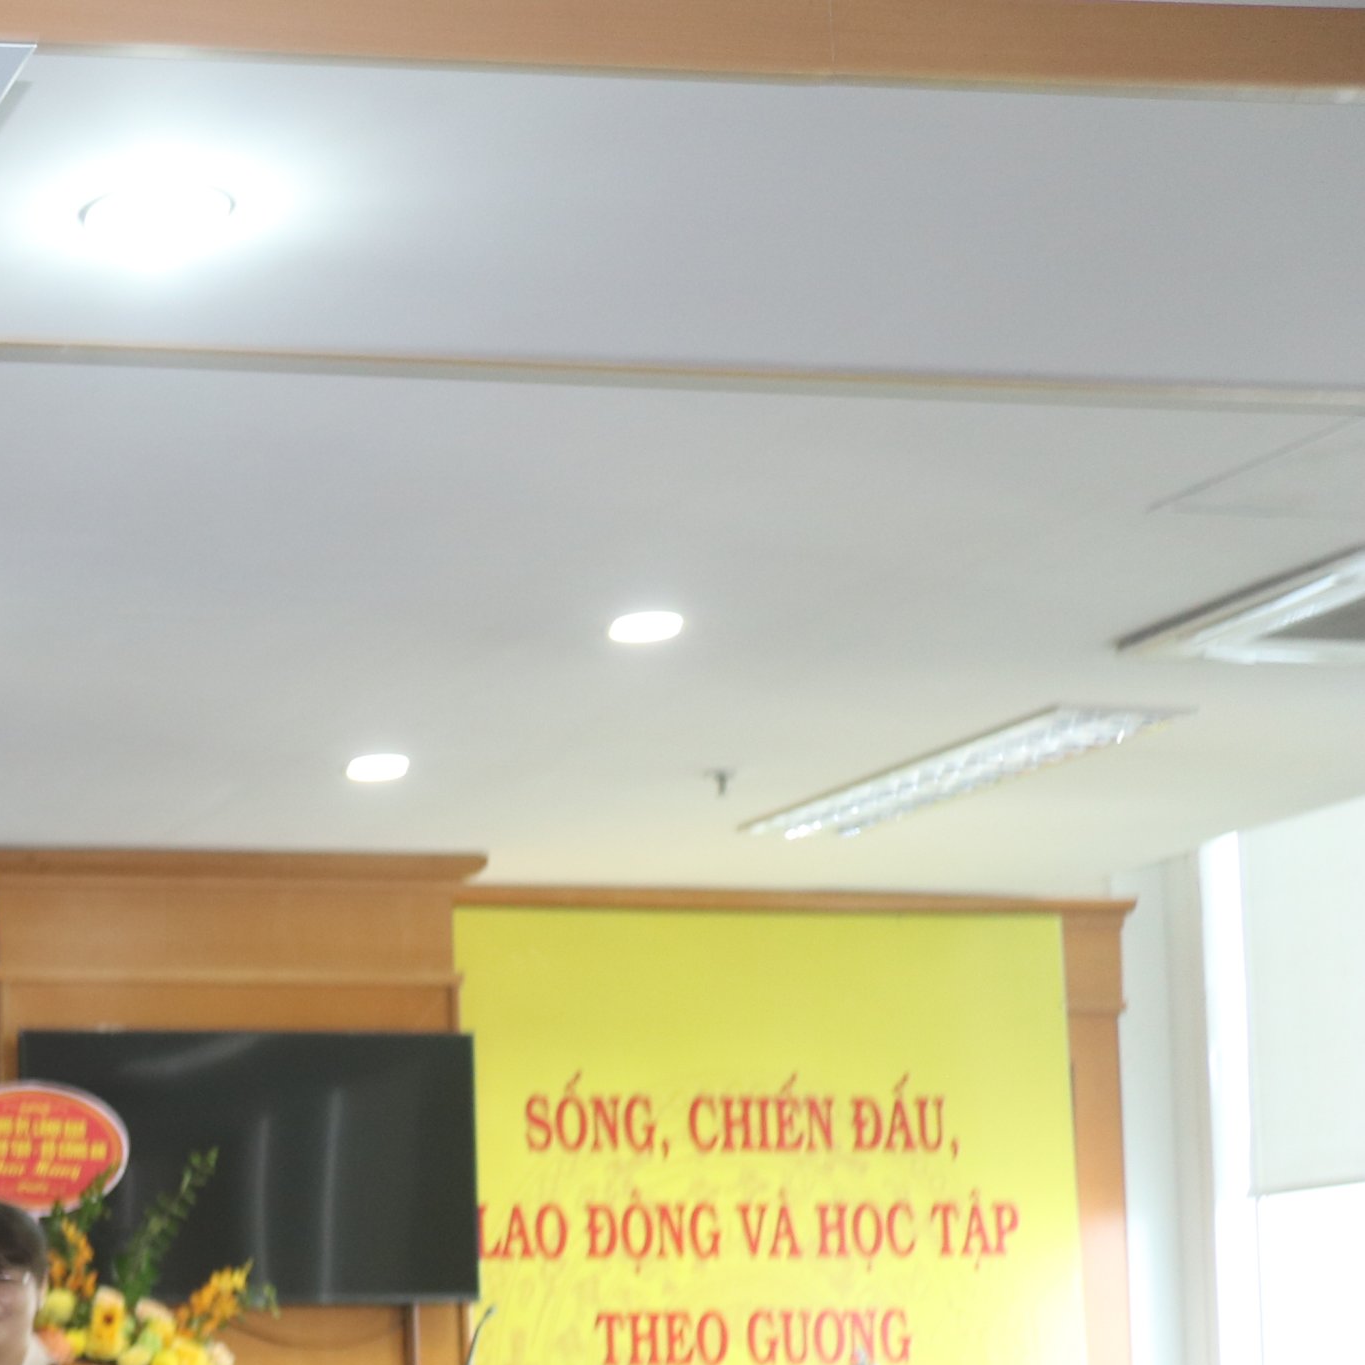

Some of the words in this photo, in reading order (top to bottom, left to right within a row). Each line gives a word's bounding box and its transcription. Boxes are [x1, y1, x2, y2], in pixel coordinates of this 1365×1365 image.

[524, 1069, 670, 1160] SỐNG,
[687, 1071, 835, 1153] CHIẾN
[851, 1071, 960, 1160] ĐẤU,
[478, 1202, 568, 1260] LAO
[586, 1187, 722, 1275] ĐỘNG
[737, 1187, 801, 1258] VÀ
[816, 1201, 917, 1271] HỌC
[929, 1187, 1020, 1271] TẬP
